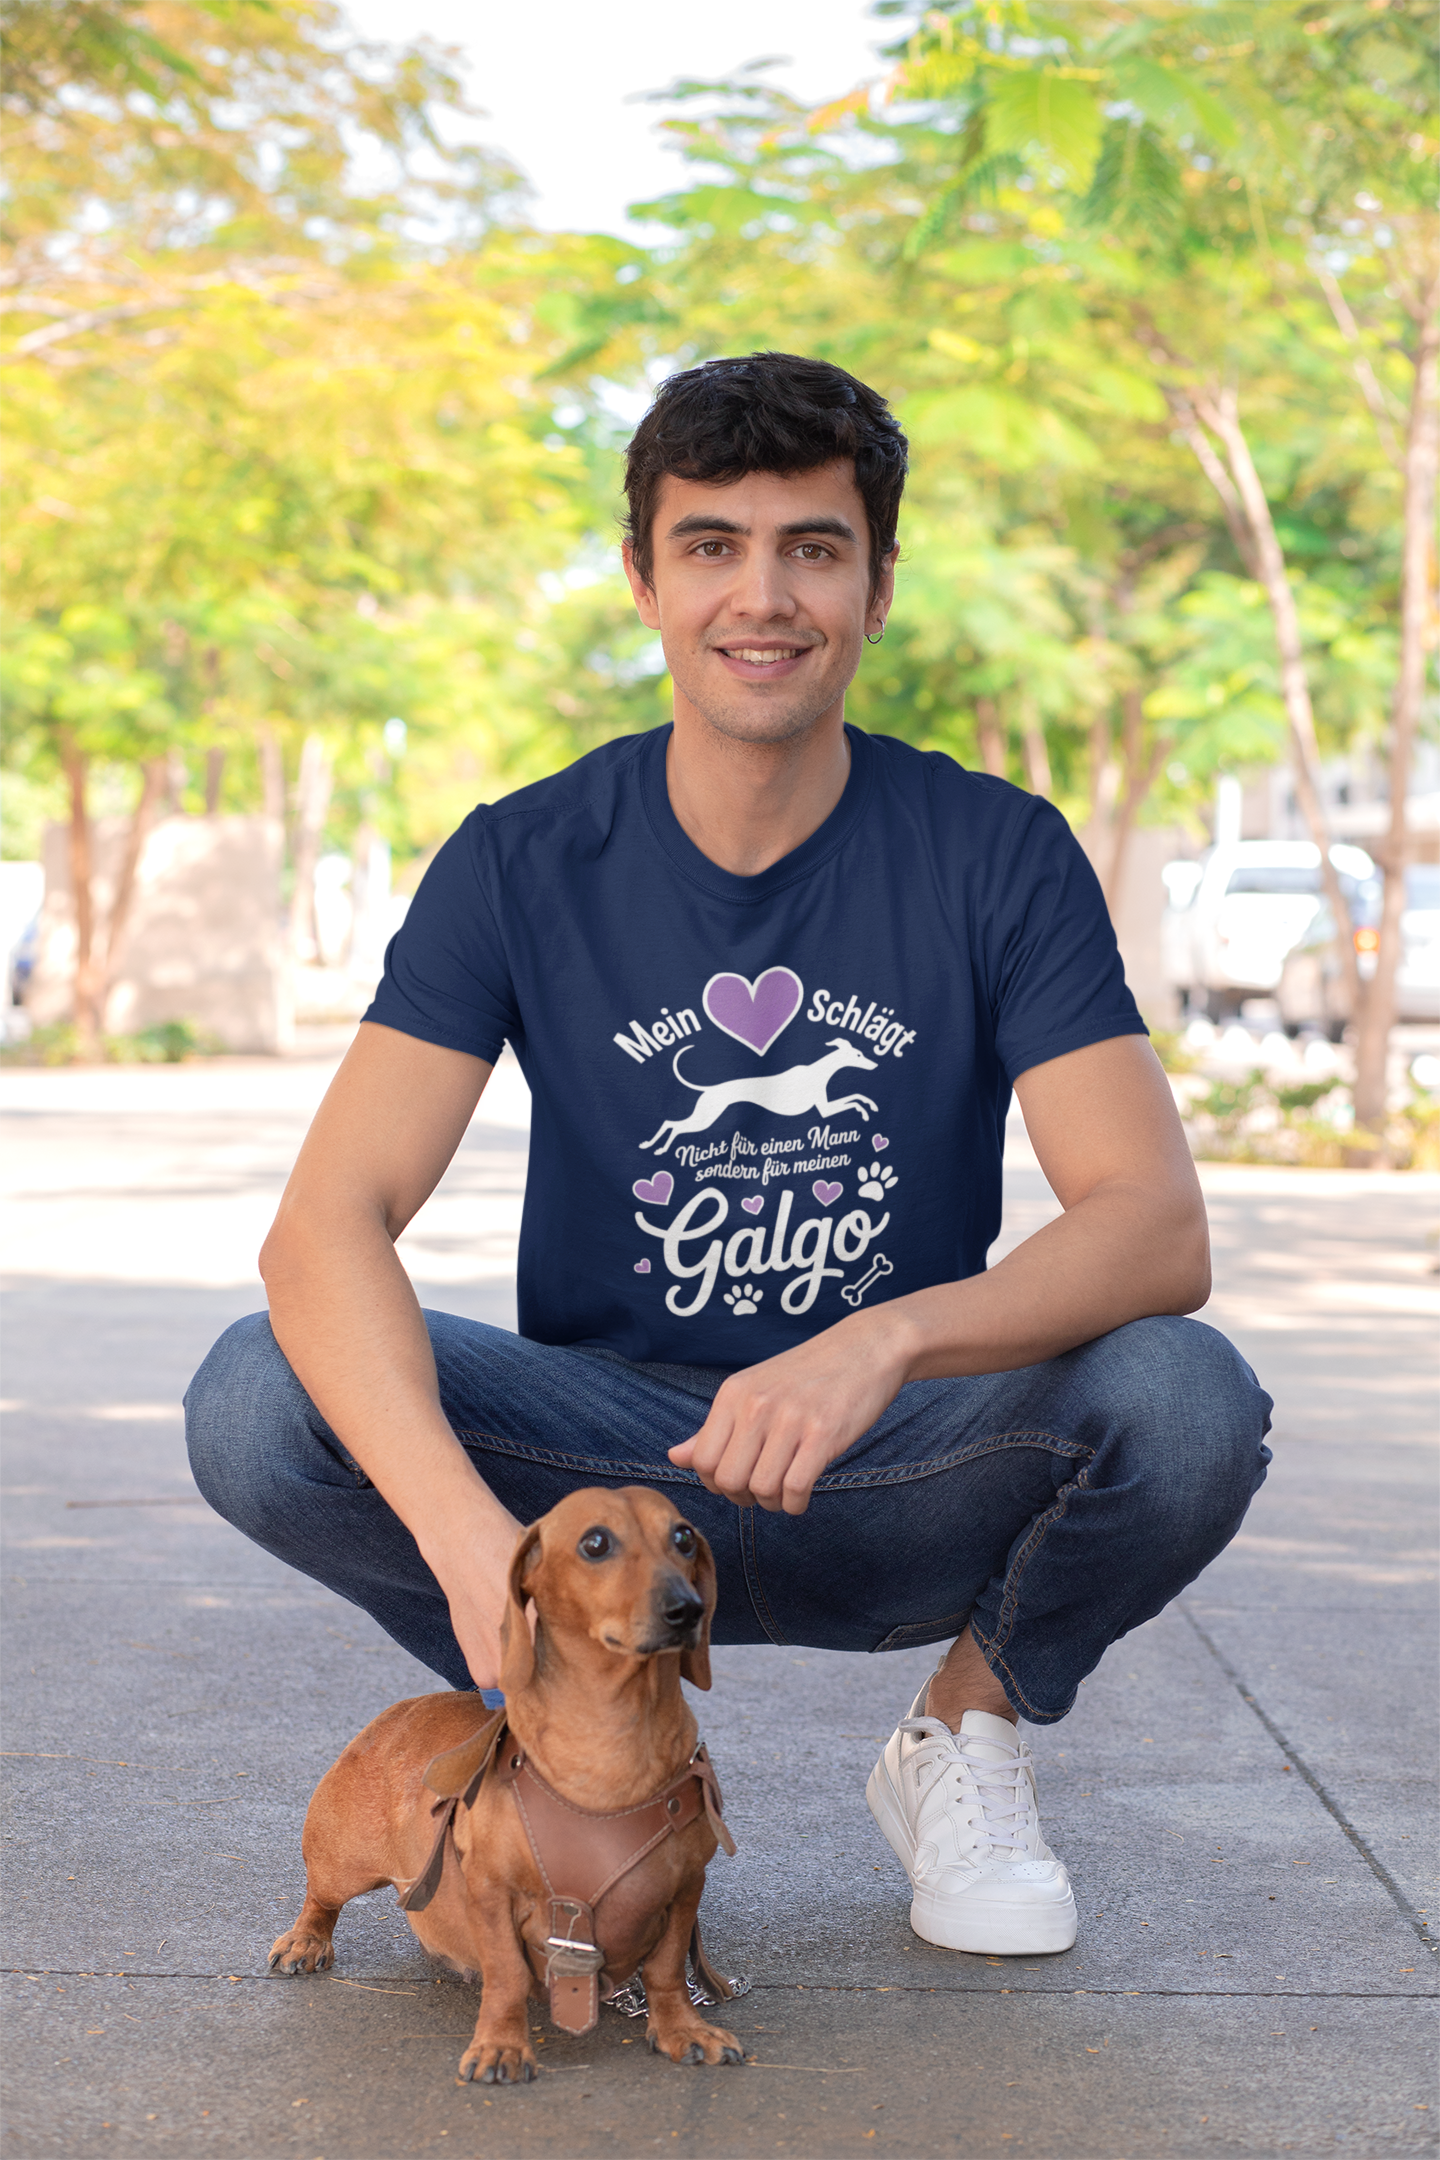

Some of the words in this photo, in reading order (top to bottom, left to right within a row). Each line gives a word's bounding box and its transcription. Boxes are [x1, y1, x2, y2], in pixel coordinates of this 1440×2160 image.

[613, 1008, 702, 1064] Mein
[807, 989, 917, 1057] Schlägt
[675, 1140, 728, 1167] Nicht
[729, 1131, 756, 1161] für
[760, 1137, 804, 1156] einen
[807, 1124, 861, 1150] Mann
[695, 1158, 760, 1182] sondern
[762, 1157, 790, 1186] für
[792, 1153, 852, 1174] meinen
[635, 1187, 890, 1317] Galgo
